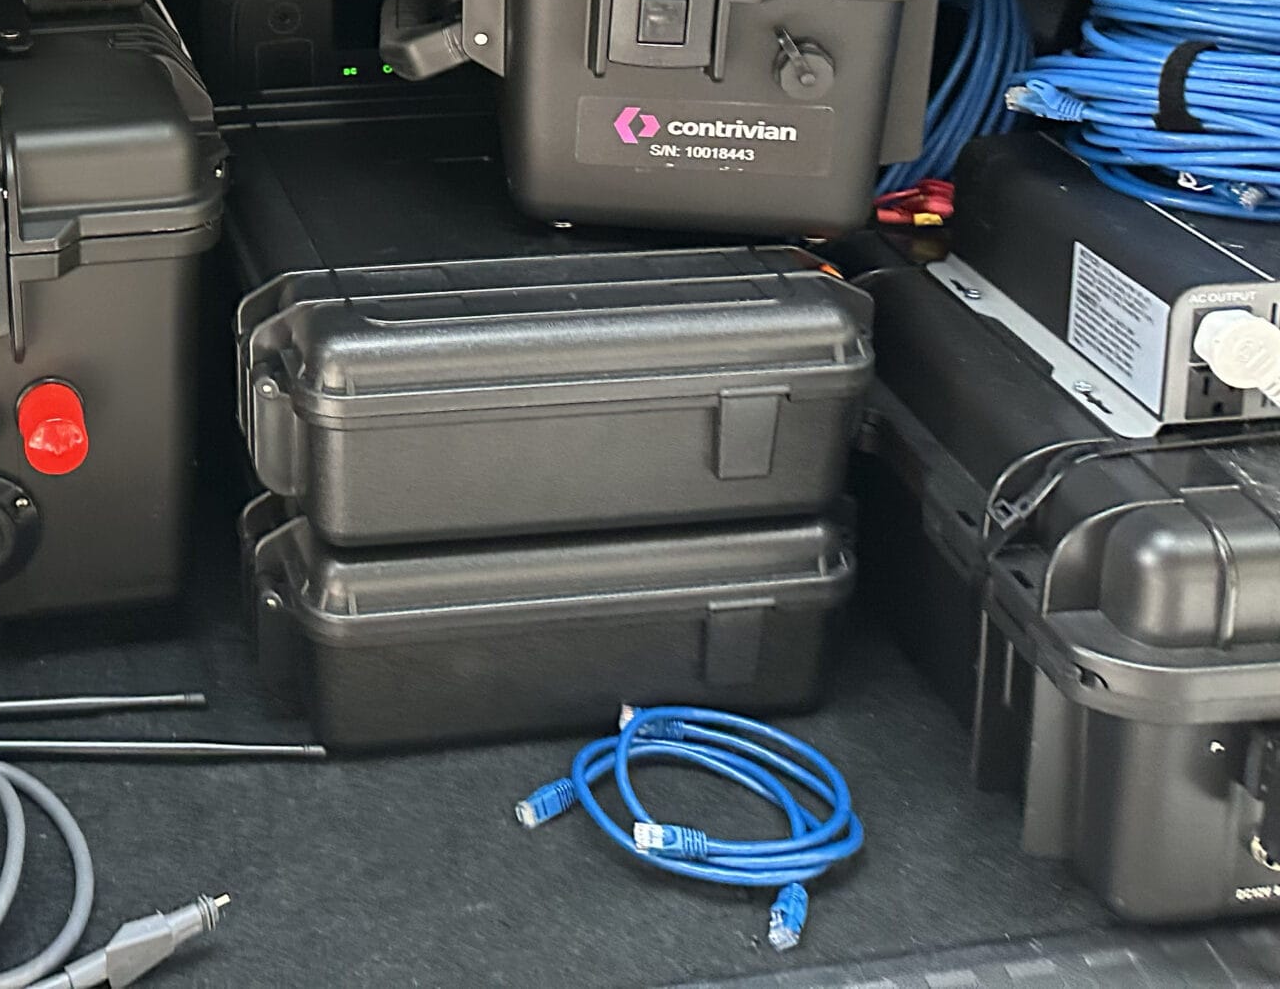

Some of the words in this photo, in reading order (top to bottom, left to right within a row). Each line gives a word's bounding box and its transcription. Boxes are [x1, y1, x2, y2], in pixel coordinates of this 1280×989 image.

[667, 119, 797, 142] contrivian
[649, 144, 681, 158] S/N:
[685, 146, 755, 161] 10018443
[1189, 292, 1208, 303] AC
[1208, 291, 1256, 302] OUTPUT
